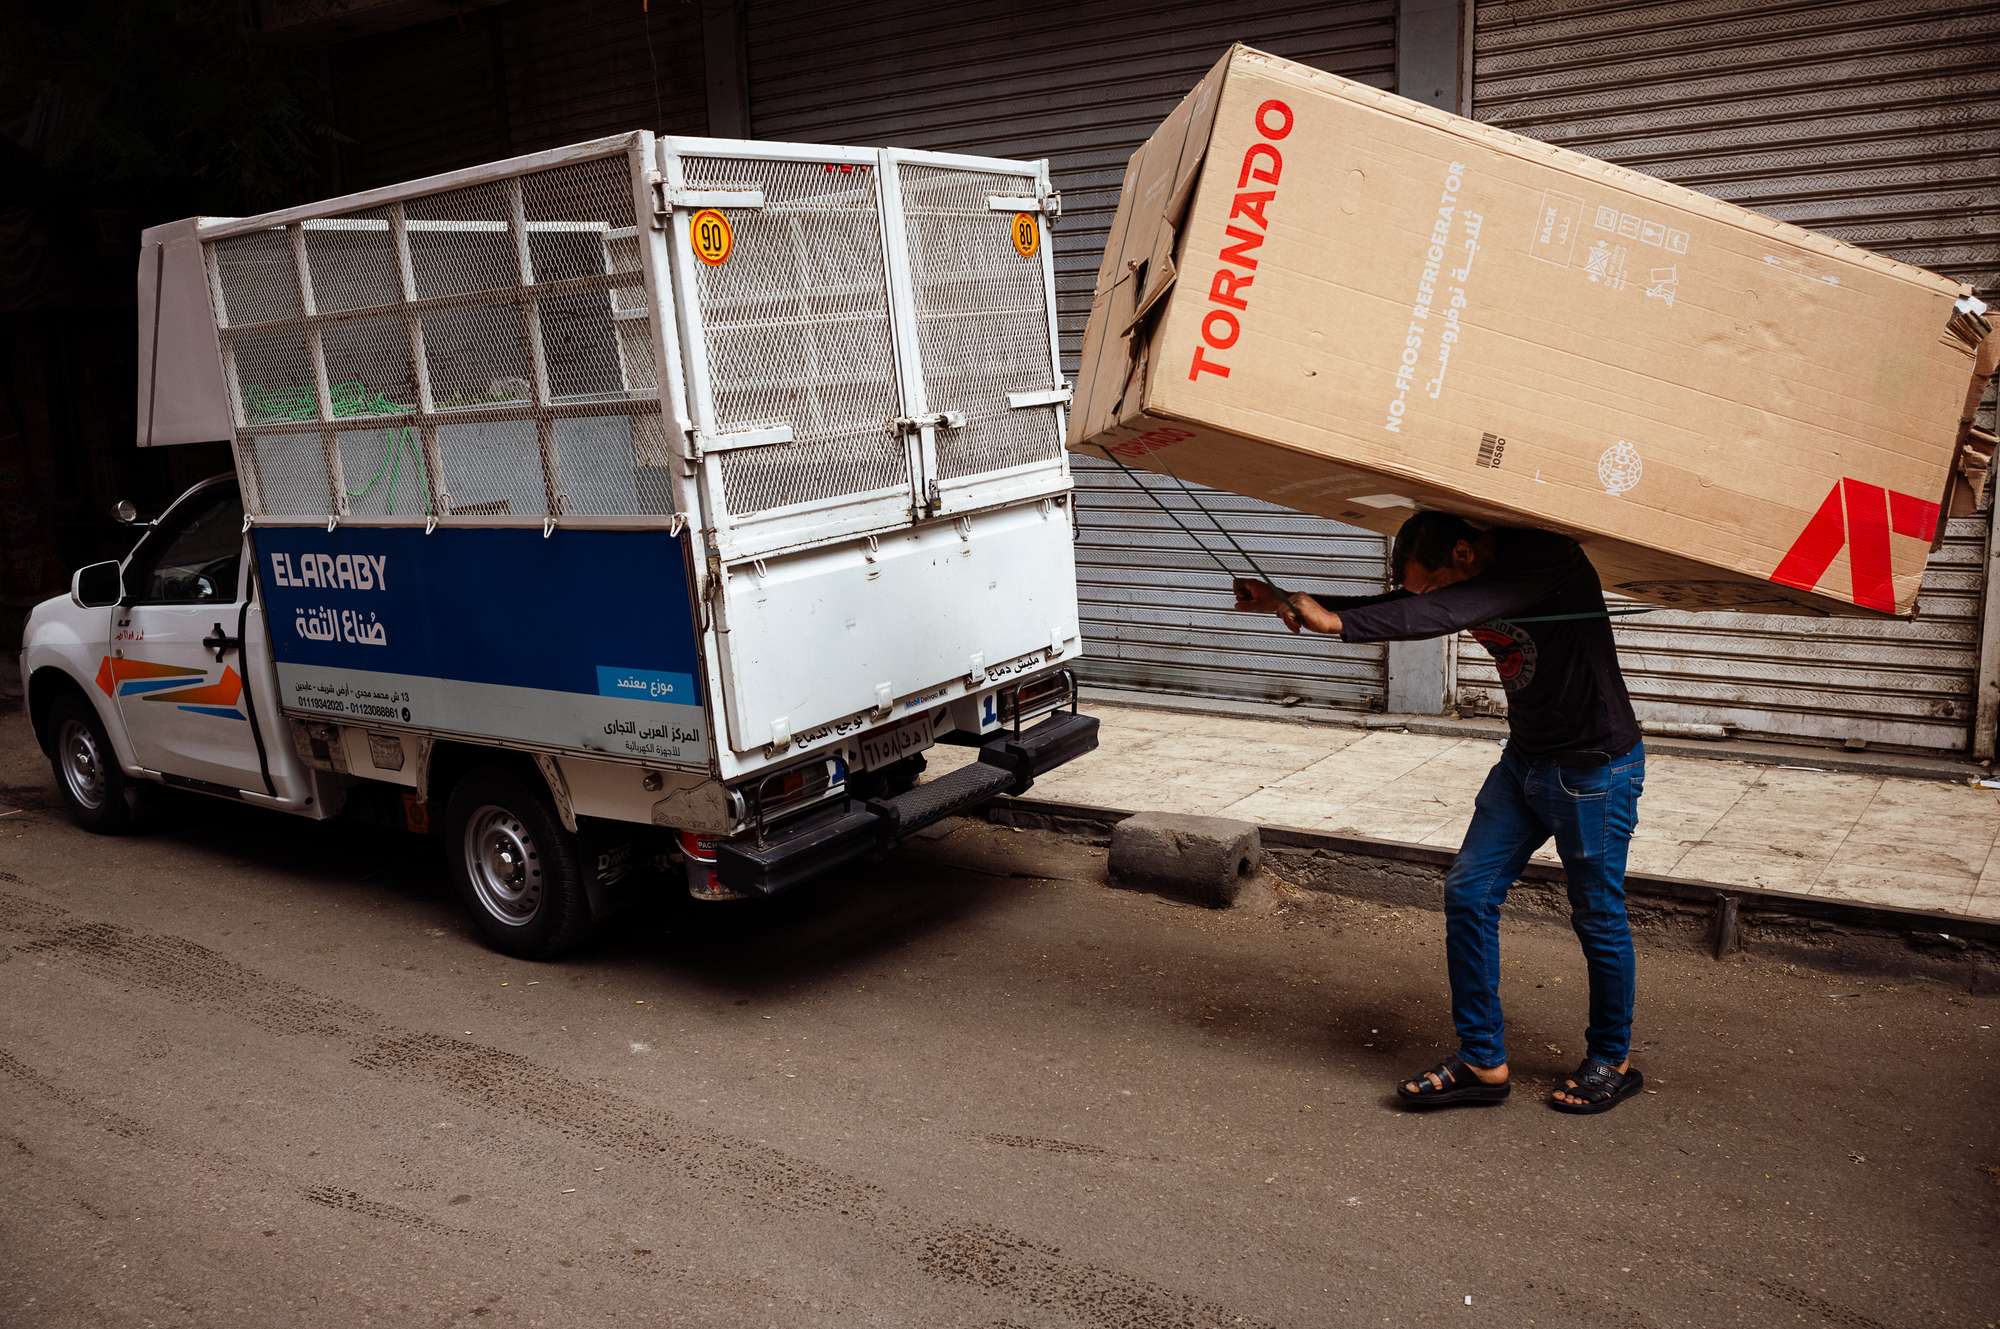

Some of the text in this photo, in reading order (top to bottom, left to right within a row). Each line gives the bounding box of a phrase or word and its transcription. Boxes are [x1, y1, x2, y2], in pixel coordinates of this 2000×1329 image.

[702, 223, 722, 251] 90
[1019, 223, 1032, 245] 80
[1539, 208, 1558, 244] BACK
[1188, 99, 1294, 383] TORNADO
[1385, 161, 1465, 432] NO-FROST REFRIGERATOR
[1491, 438, 1506, 469] 10580
[271, 552, 386, 591] ELARABY
[295, 605, 342, 642] الثقة
[988, 656, 1040, 681] مليش دماغ
[373, 690, 389, 700] محمد
[401, 693, 410, 702] 13
[617, 675, 673, 697] موزع معتمد
[982, 695, 997, 727] 1
[671, 728, 699, 743] المركز
[794, 727, 833, 748] الدماغ
